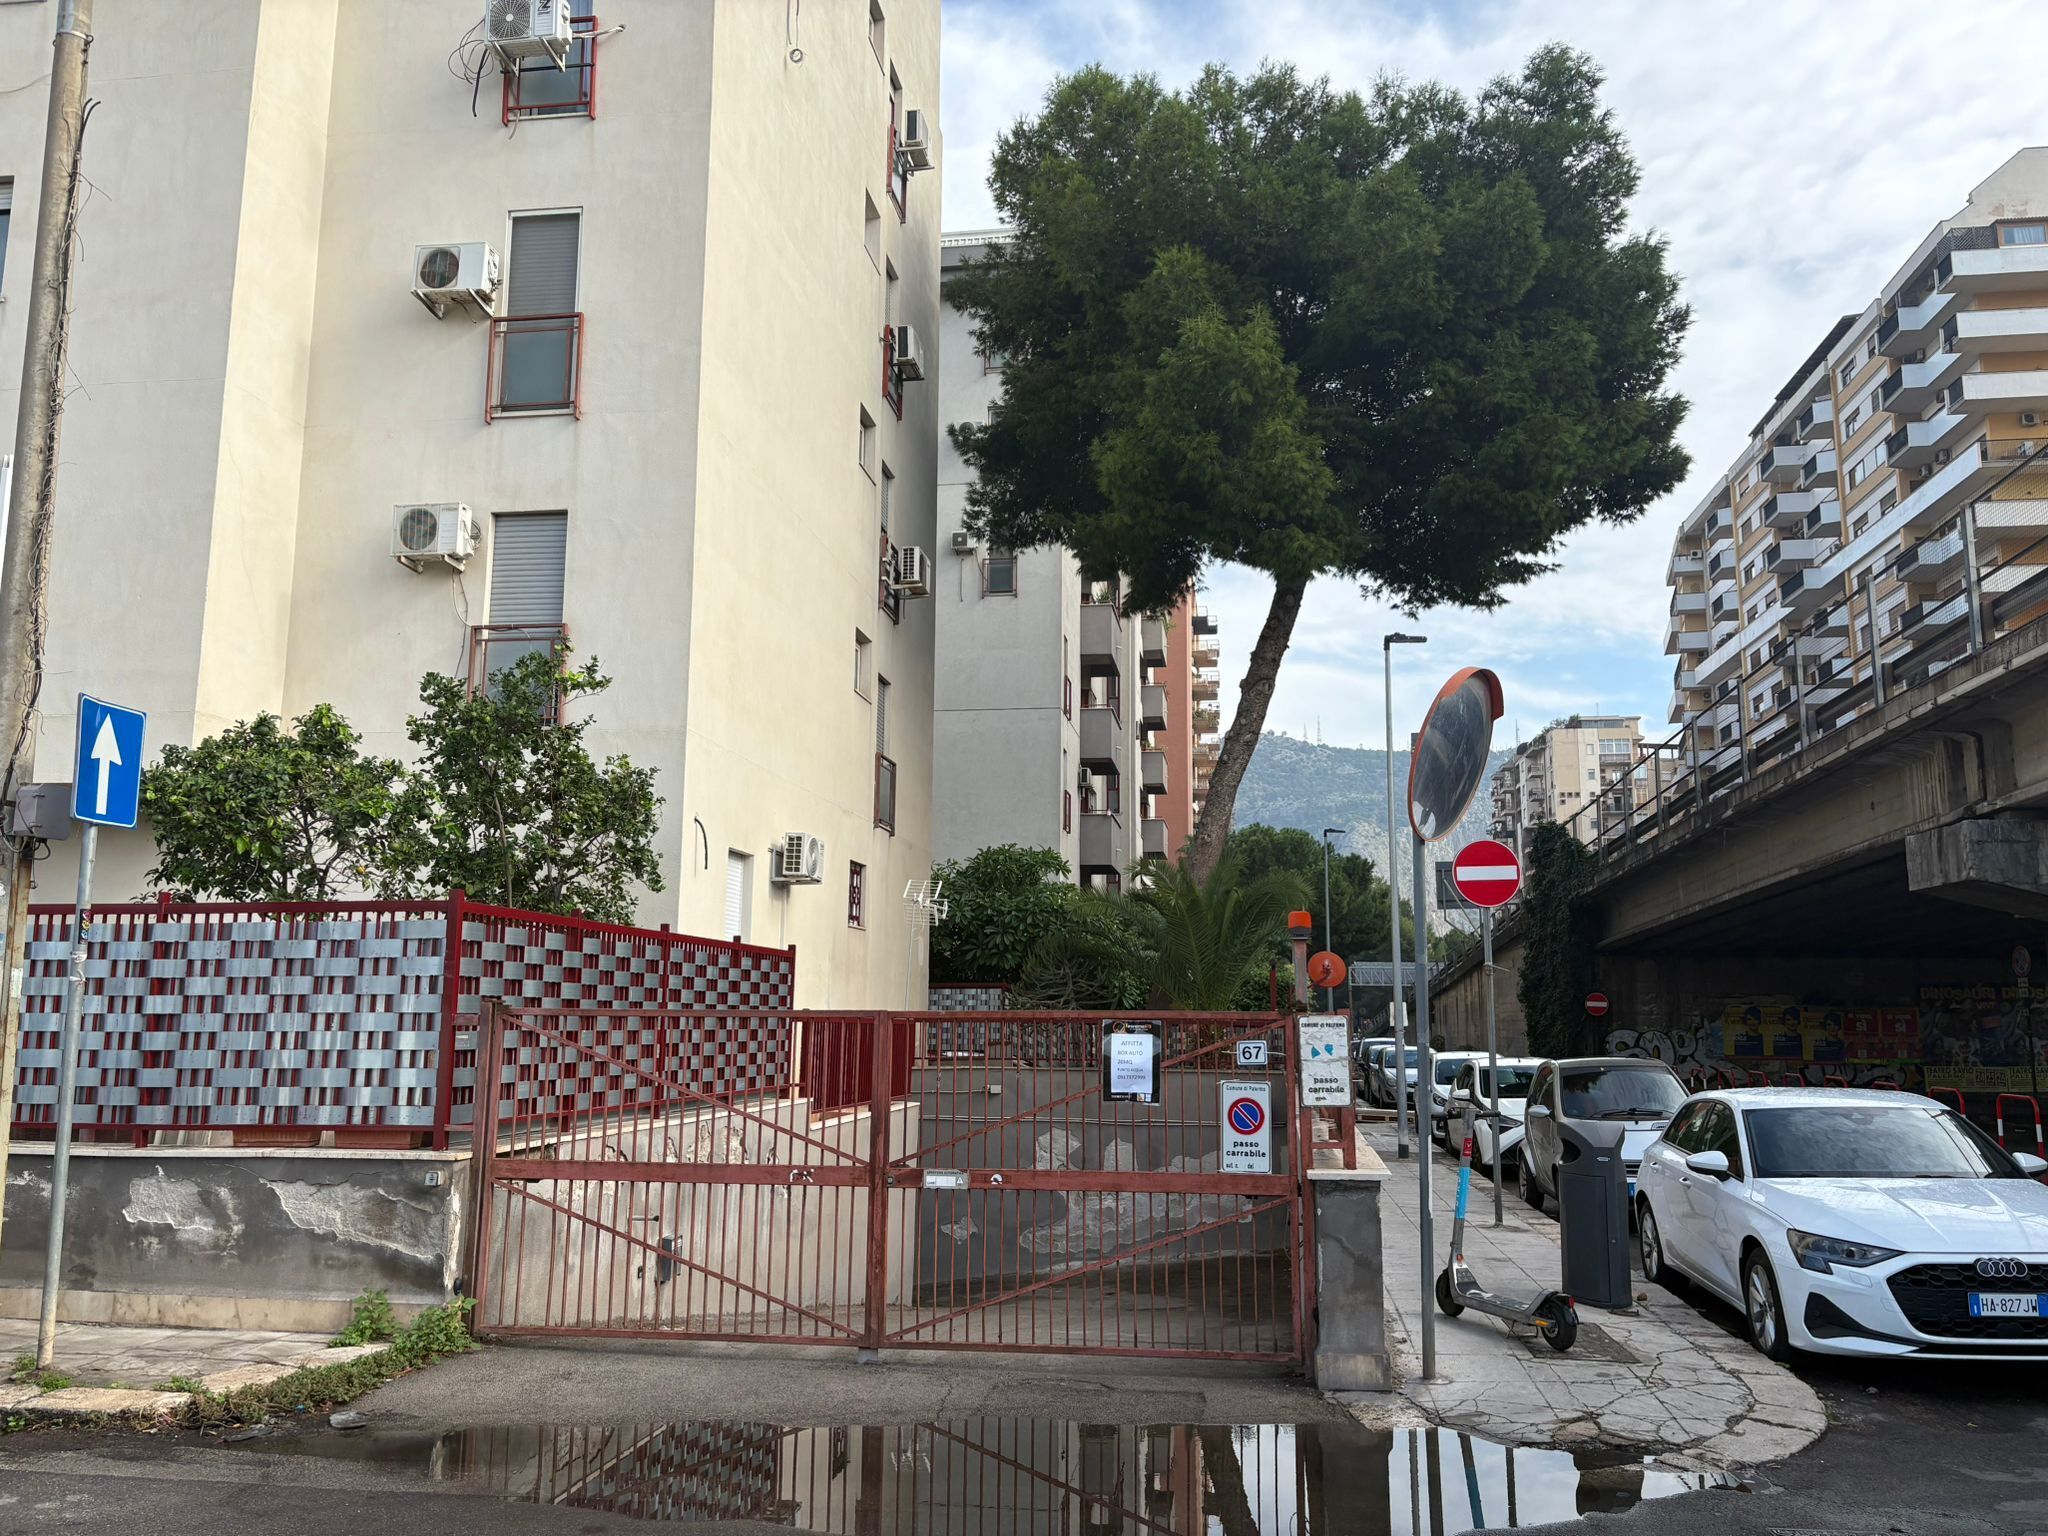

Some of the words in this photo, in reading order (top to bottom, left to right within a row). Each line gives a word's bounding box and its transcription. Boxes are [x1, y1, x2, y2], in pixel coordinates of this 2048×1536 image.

[1920, 987, 1997, 1000] DINOSAURI
[1242, 1046, 1262, 1060] 67
[1313, 1077, 1339, 1085] passo
[1308, 1085, 1345, 1093] carrabile
[1233, 1141, 1259, 1149] passo
[1226, 1149, 1266, 1158] carrabile
